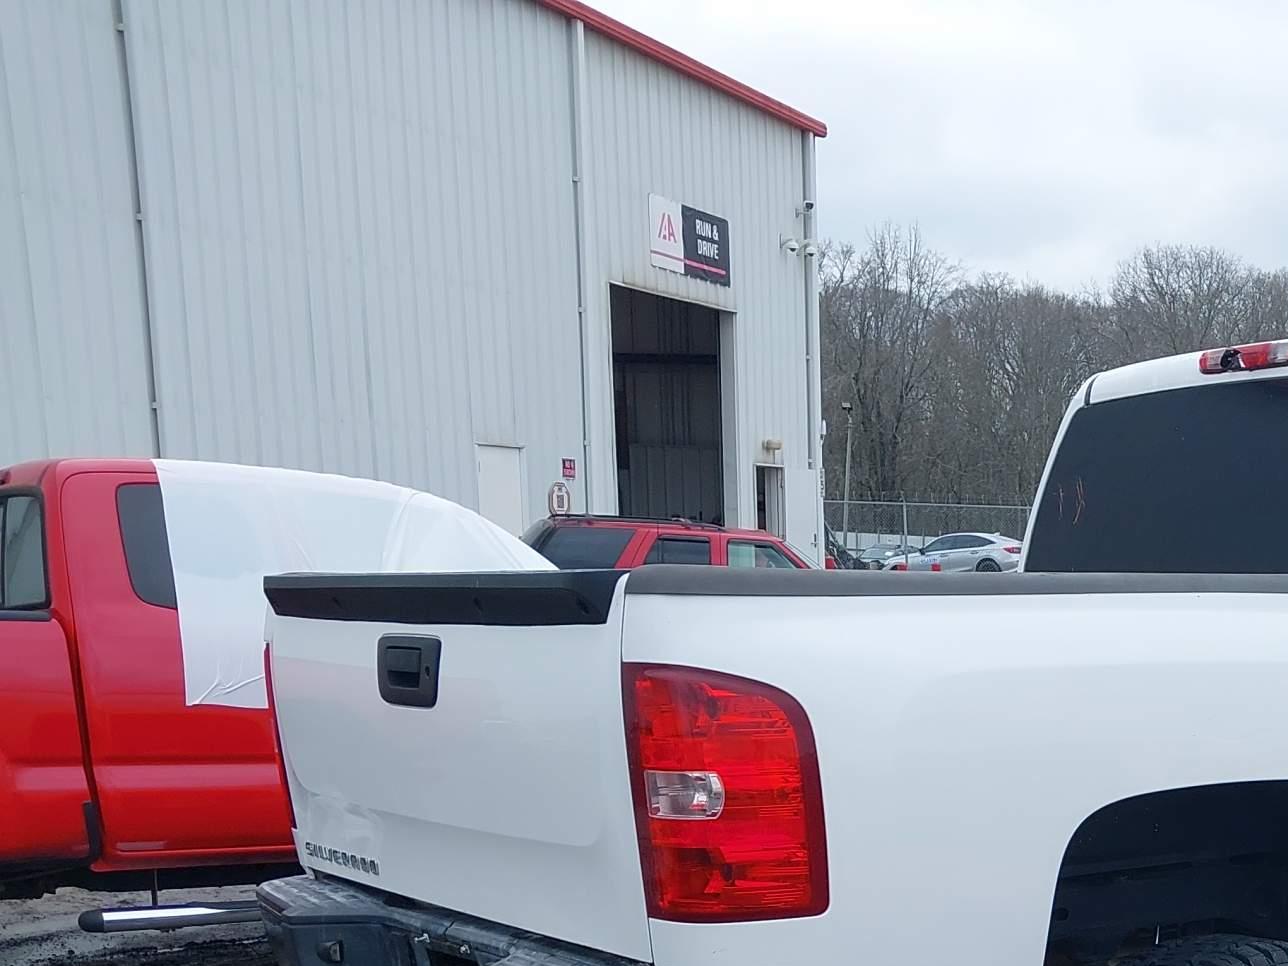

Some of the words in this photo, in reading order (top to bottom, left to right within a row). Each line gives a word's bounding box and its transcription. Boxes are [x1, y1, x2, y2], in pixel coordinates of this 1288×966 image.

[695, 219, 711, 239] RUN
[712, 225, 720, 241] &
[697, 239, 719, 260] DRIVE
[305, 841, 380, 876] SILVERADO
